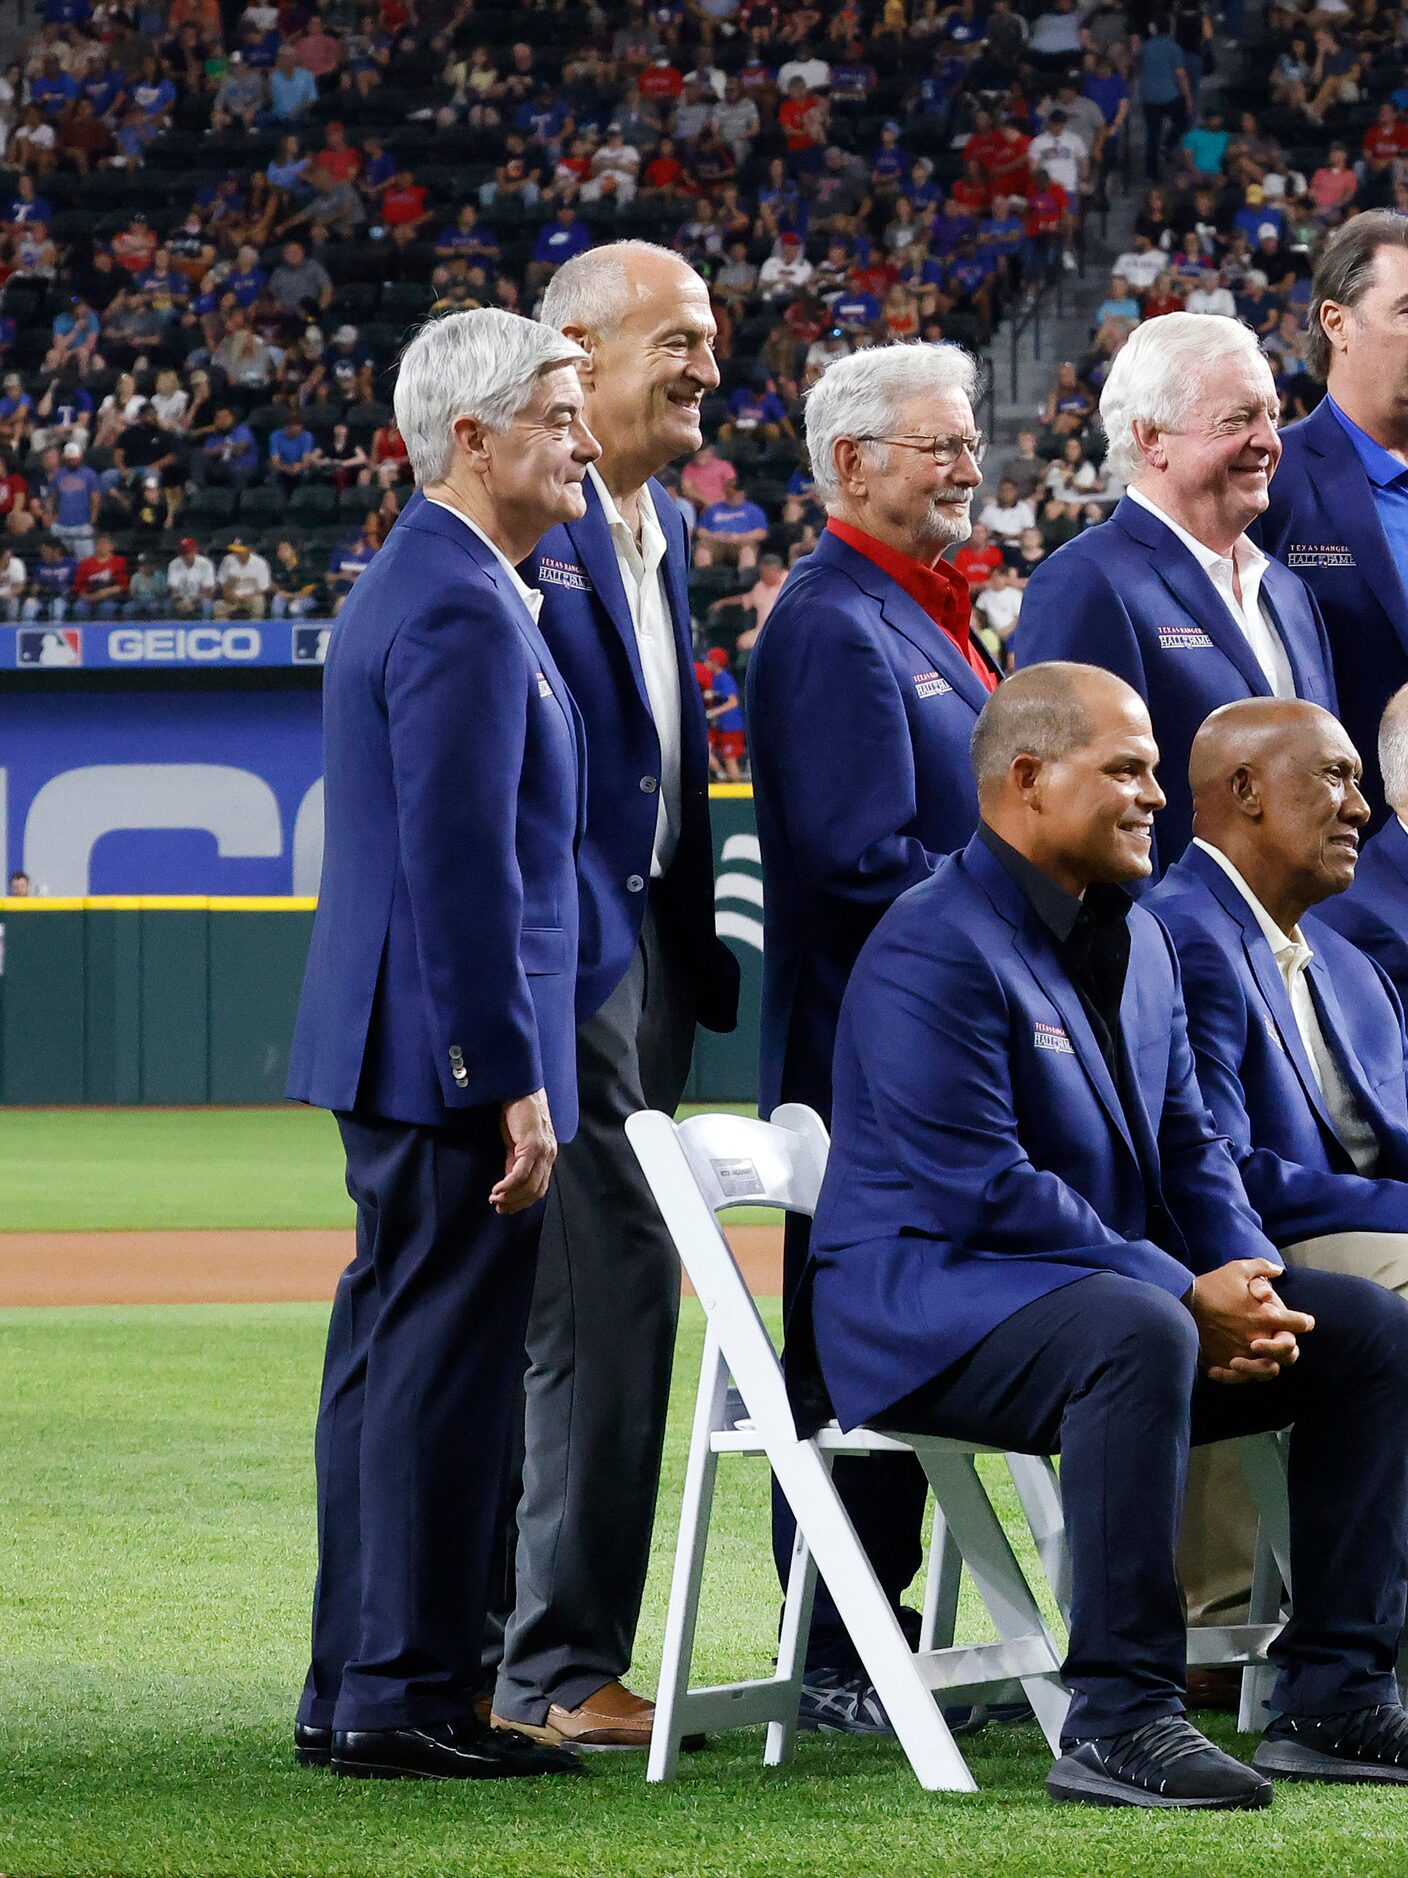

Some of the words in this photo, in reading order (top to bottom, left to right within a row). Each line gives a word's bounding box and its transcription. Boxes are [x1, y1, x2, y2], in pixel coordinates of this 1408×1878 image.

[1290, 544, 1319, 552] TEXAS
[541, 557, 564, 569] TEXAS
[1288, 555, 1318, 564] HALL
[539, 567, 562, 582] HALL
[1158, 626, 1180, 634] TEXAS
[108, 628, 262, 661] GEICO
[1160, 636, 1184, 646] HALL
[917, 682, 935, 696] HALL
[1034, 1033, 1053, 1046] HALL
